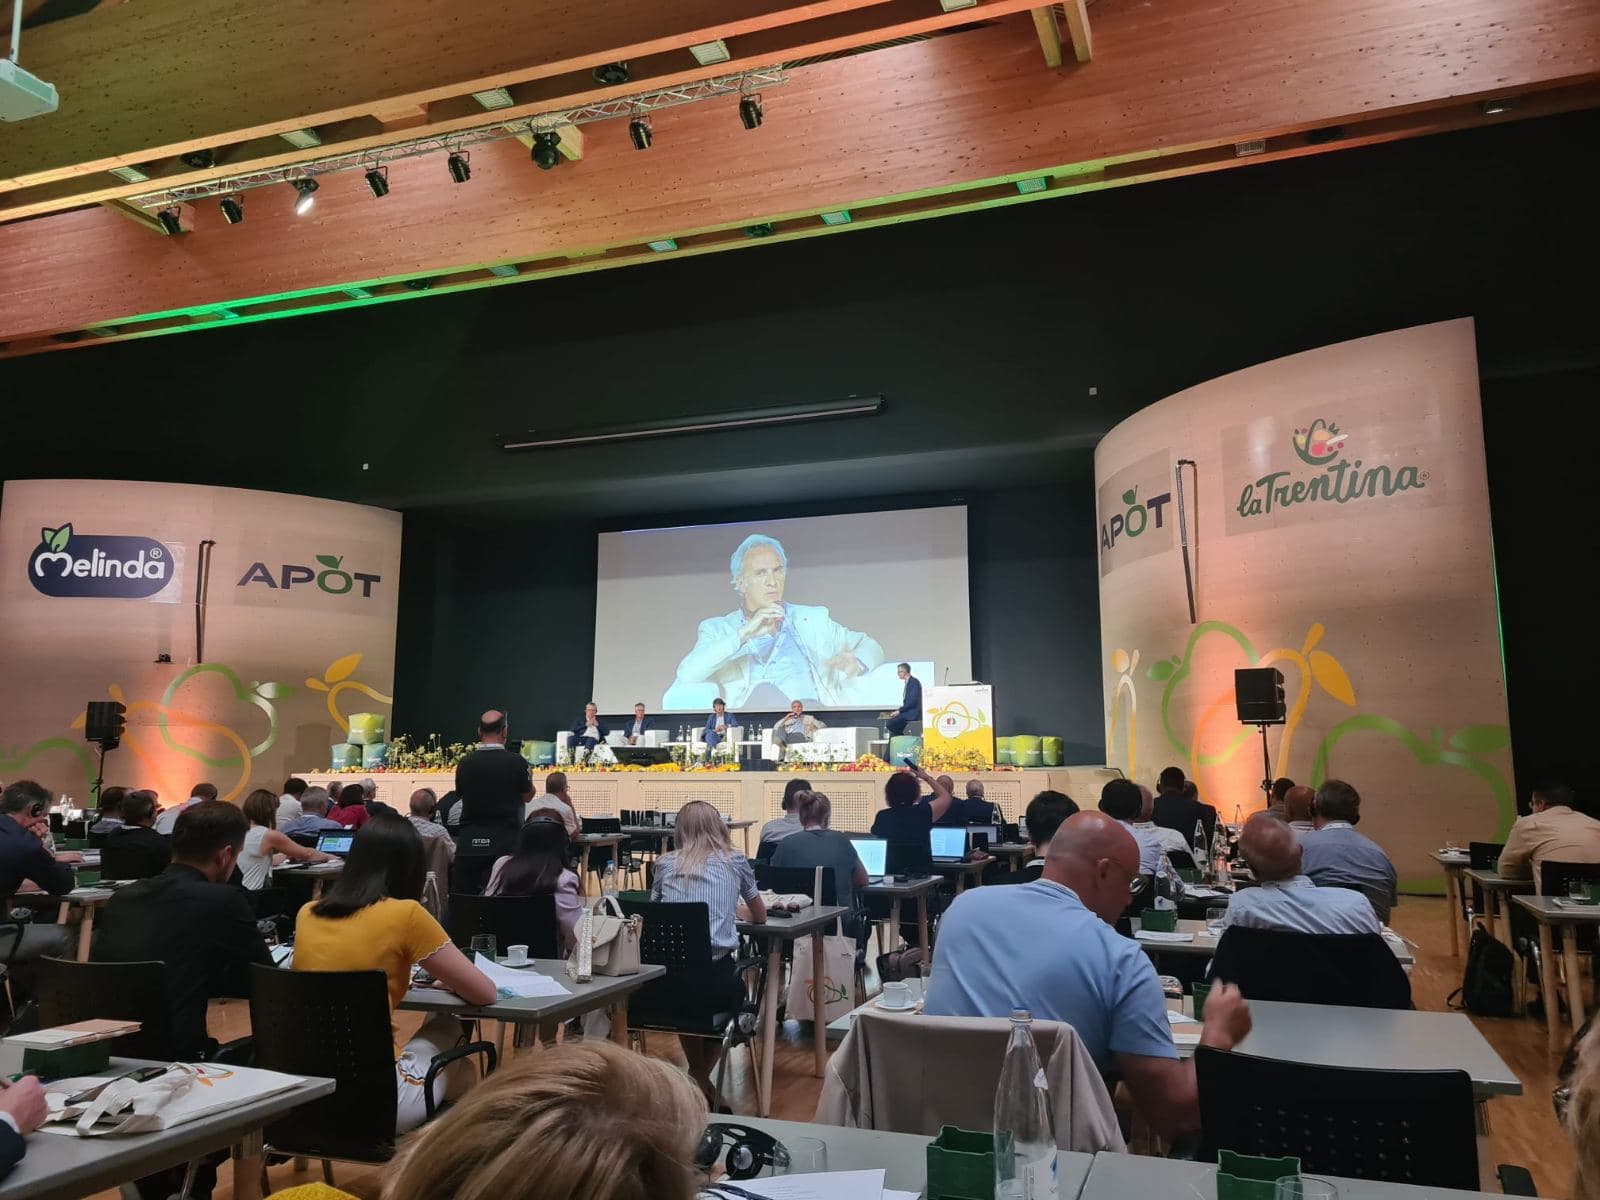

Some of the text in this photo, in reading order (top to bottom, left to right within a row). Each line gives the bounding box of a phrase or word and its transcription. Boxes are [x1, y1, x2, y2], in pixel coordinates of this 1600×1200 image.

[1100, 492, 1171, 555] APOT
[34, 548, 165, 580] Melinda
[237, 561, 381, 598] APOT
